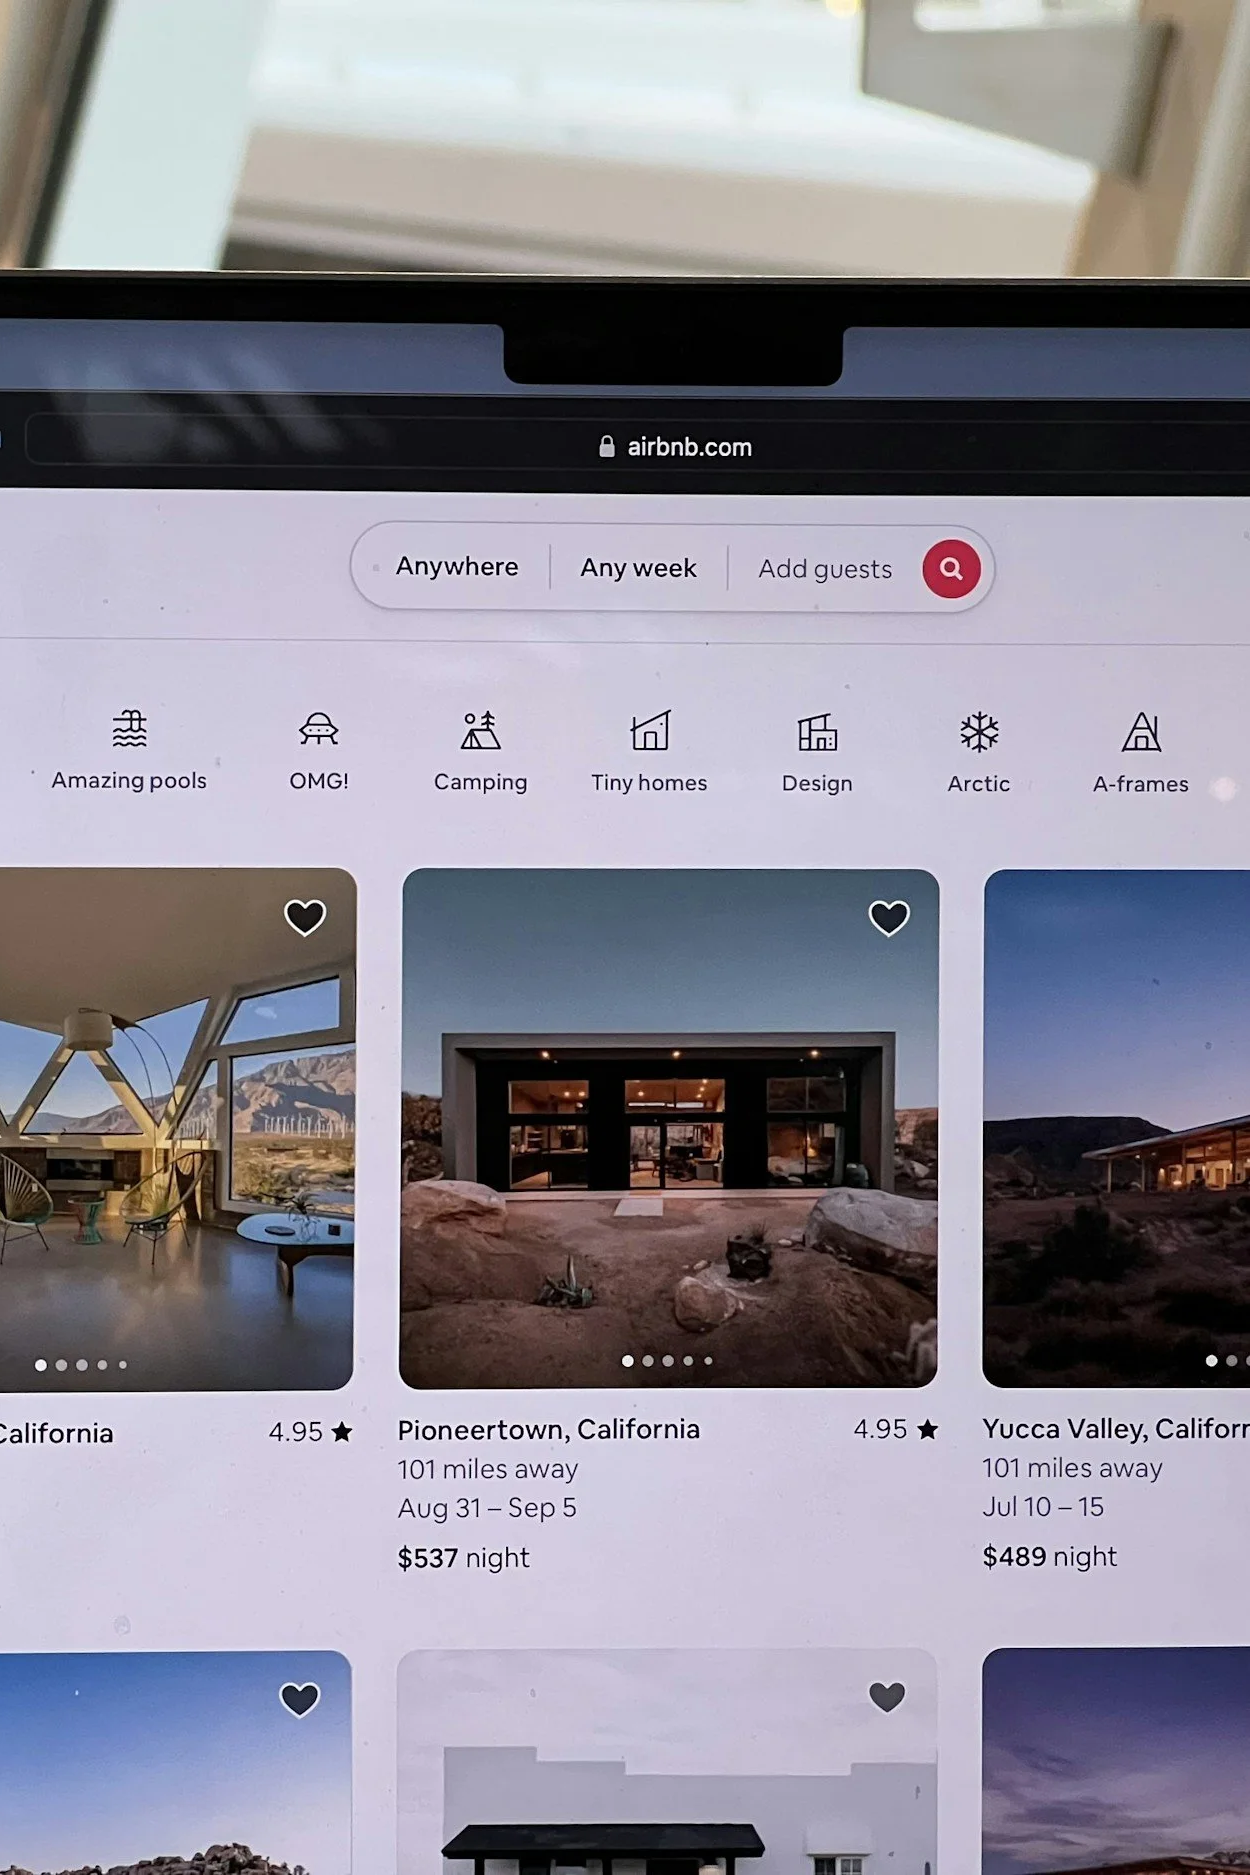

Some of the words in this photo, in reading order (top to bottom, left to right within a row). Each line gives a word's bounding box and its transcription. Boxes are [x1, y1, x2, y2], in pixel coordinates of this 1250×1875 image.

[627, 435, 753, 457] airbnb.com
[395, 555, 519, 581] Anywhere
[580, 557, 628, 583] Any
[632, 557, 698, 578] week
[758, 557, 807, 579] Add
[814, 559, 893, 584] guests
[51, 771, 144, 794] Amazing
[149, 771, 207, 794] pools
[289, 772, 348, 790] OMG!
[434, 772, 528, 795] Camping
[591, 773, 634, 796] Tiny
[638, 773, 708, 792] homes
[782, 774, 853, 797] Design
[947, 774, 1011, 793] Arctic
[1092, 774, 1189, 793] A-frames
[268, 1421, 323, 1443] 4.95
[398, 1419, 571, 1445] Pioneertown,
[577, 1417, 700, 1440] California
[853, 1418, 908, 1440] 4.95
[982, 1417, 1060, 1440] Yucca
[1066, 1417, 1149, 1445] Valley,
[397, 1459, 434, 1480] 101
[443, 1456, 508, 1480] miles
[515, 1462, 579, 1485] away
[982, 1457, 1019, 1479] 101
[1028, 1456, 1092, 1479] miles
[1099, 1462, 1164, 1484] away
[397, 1497, 448, 1525] Aug
[455, 1497, 480, 1519] 31
[508, 1496, 556, 1524] Sep
[562, 1497, 577, 1518] 5
[982, 1494, 1017, 1517] Jul
[1024, 1496, 1052, 1517] 10
[1078, 1496, 1104, 1517] 15
[397, 1544, 459, 1573] $537
[466, 1545, 531, 1574] night
[983, 1542, 1047, 1571] $489
[1054, 1544, 1118, 1573] night
